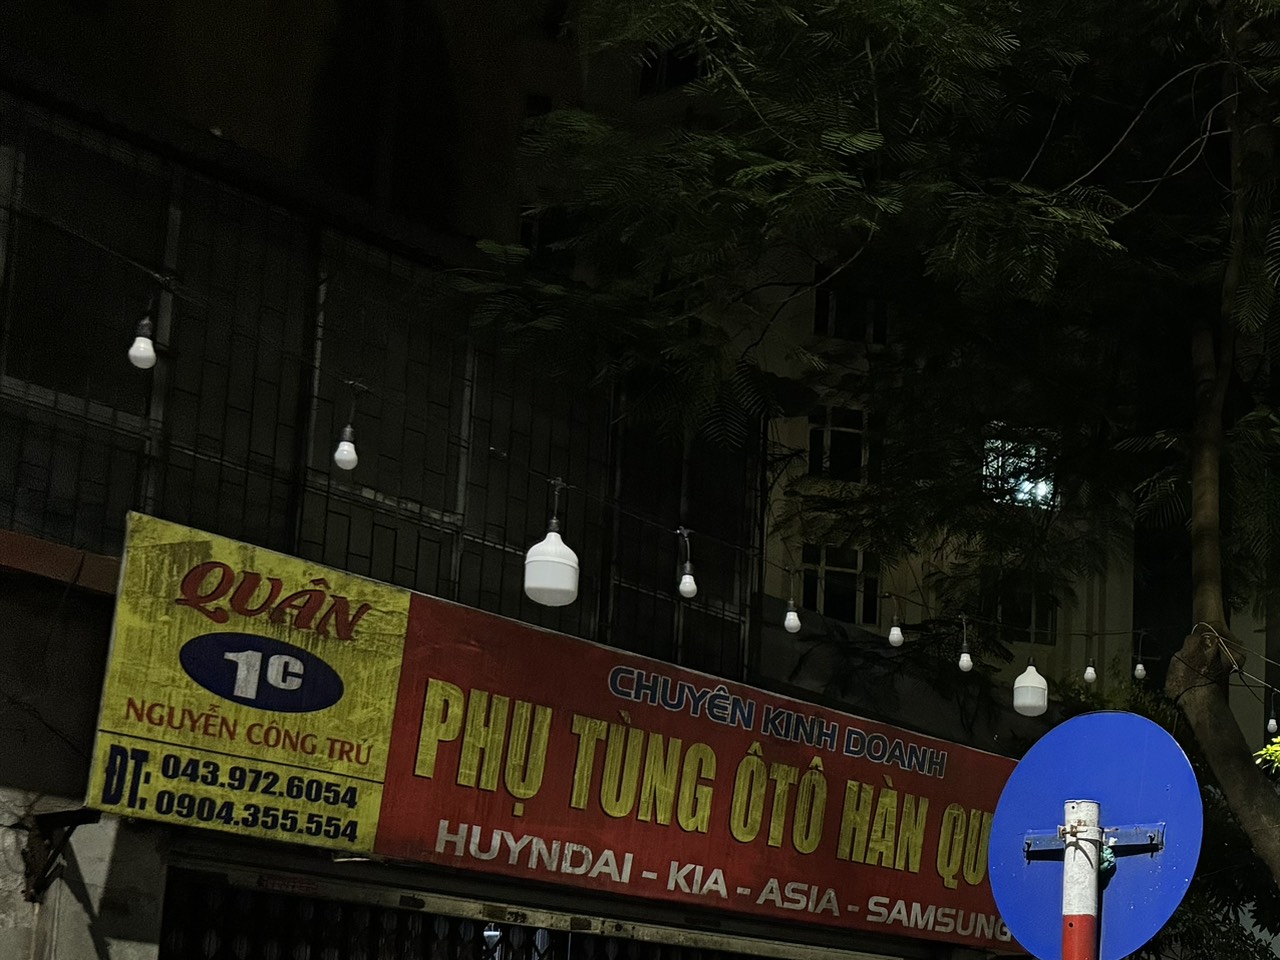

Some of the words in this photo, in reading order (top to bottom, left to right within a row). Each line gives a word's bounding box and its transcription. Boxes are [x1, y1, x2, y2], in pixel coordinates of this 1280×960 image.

[246, 720, 317, 755] CÔNG
[608, 665, 755, 730] CHUYÊN
[761, 705, 838, 751] KINH
[844, 727, 947, 778] DOANH
[154, 790, 358, 842] 0904.355.554
[161, 754, 358, 808] 043.972.6054
[414, 678, 552, 816] PHỤ
[571, 710, 716, 832] TÙNG
[730, 741, 827, 854] ÔTÔ
[837, 775, 928, 873] HÀN
[937, 803, 993, 889] QU
[435, 819, 633, 884] HUYNDAI
[667, 861, 728, 898] KIA
[756, 878, 840, 917] ASIA
[867, 895, 1012, 942] SAMSUNG
